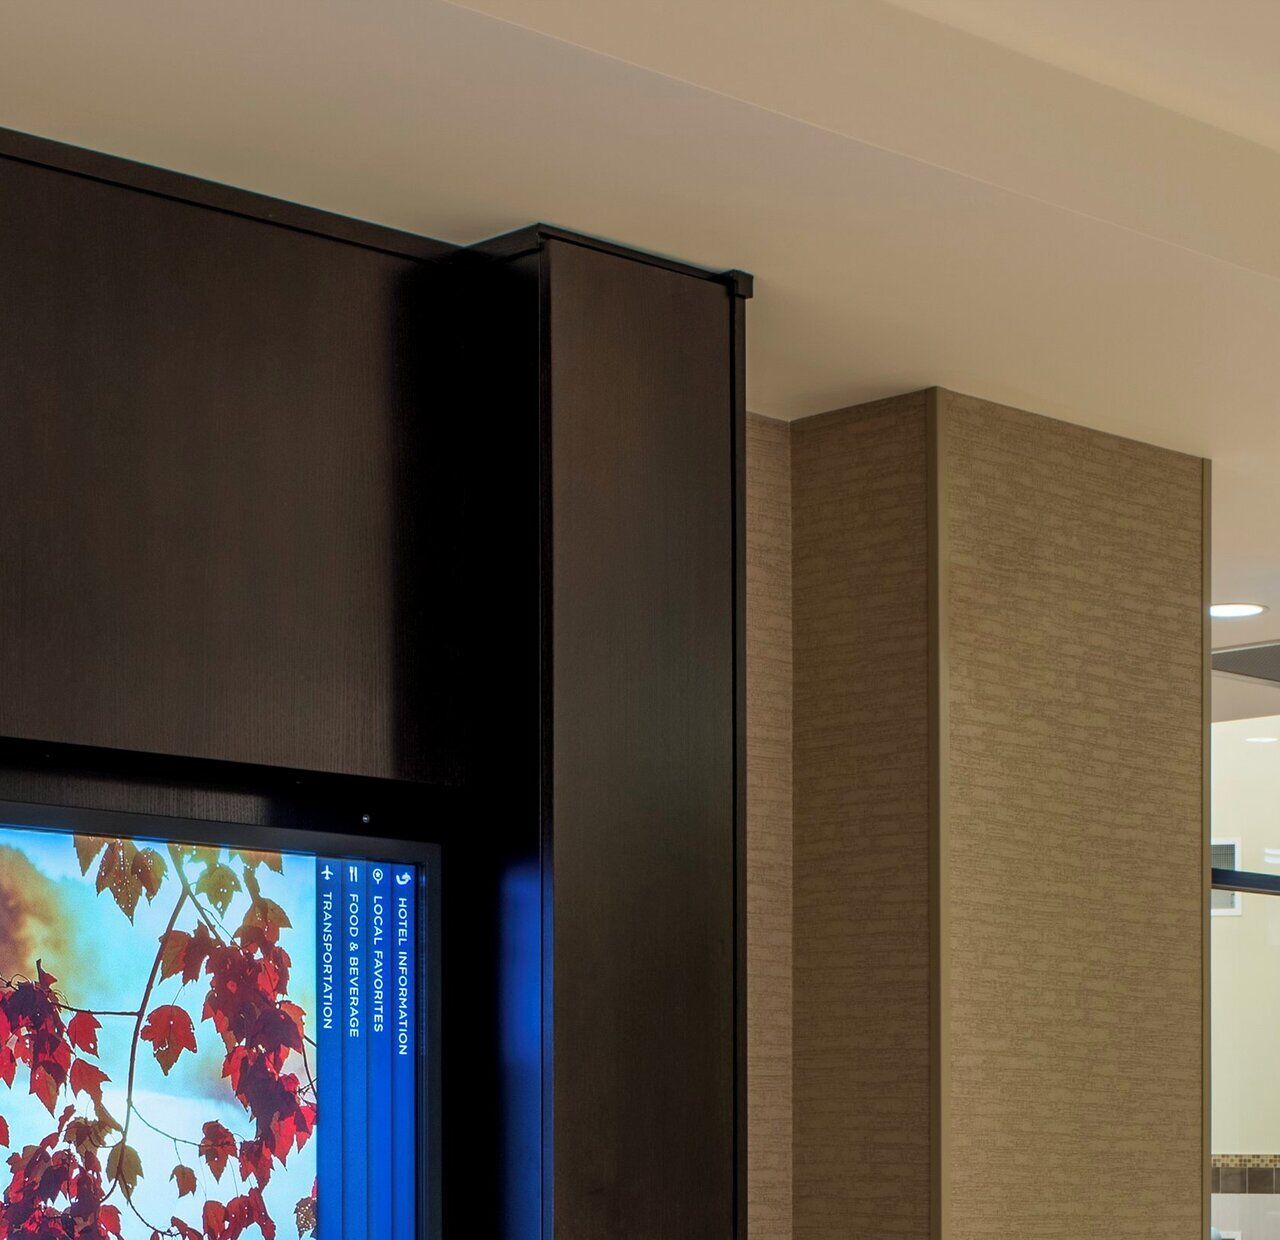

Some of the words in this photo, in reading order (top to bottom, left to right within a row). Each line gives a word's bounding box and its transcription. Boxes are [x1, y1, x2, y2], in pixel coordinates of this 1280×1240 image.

[349, 893, 359, 938] FOOD
[349, 942, 359, 952] &
[373, 896, 383, 946] LOCAL
[398, 897, 408, 946] HOTEL
[322, 891, 333, 1030] TRANSPORTATION
[373, 950, 384, 1032] FAVORITES
[349, 957, 360, 1038] BEVERAGE
[398, 951, 408, 1055] INFORMATION
